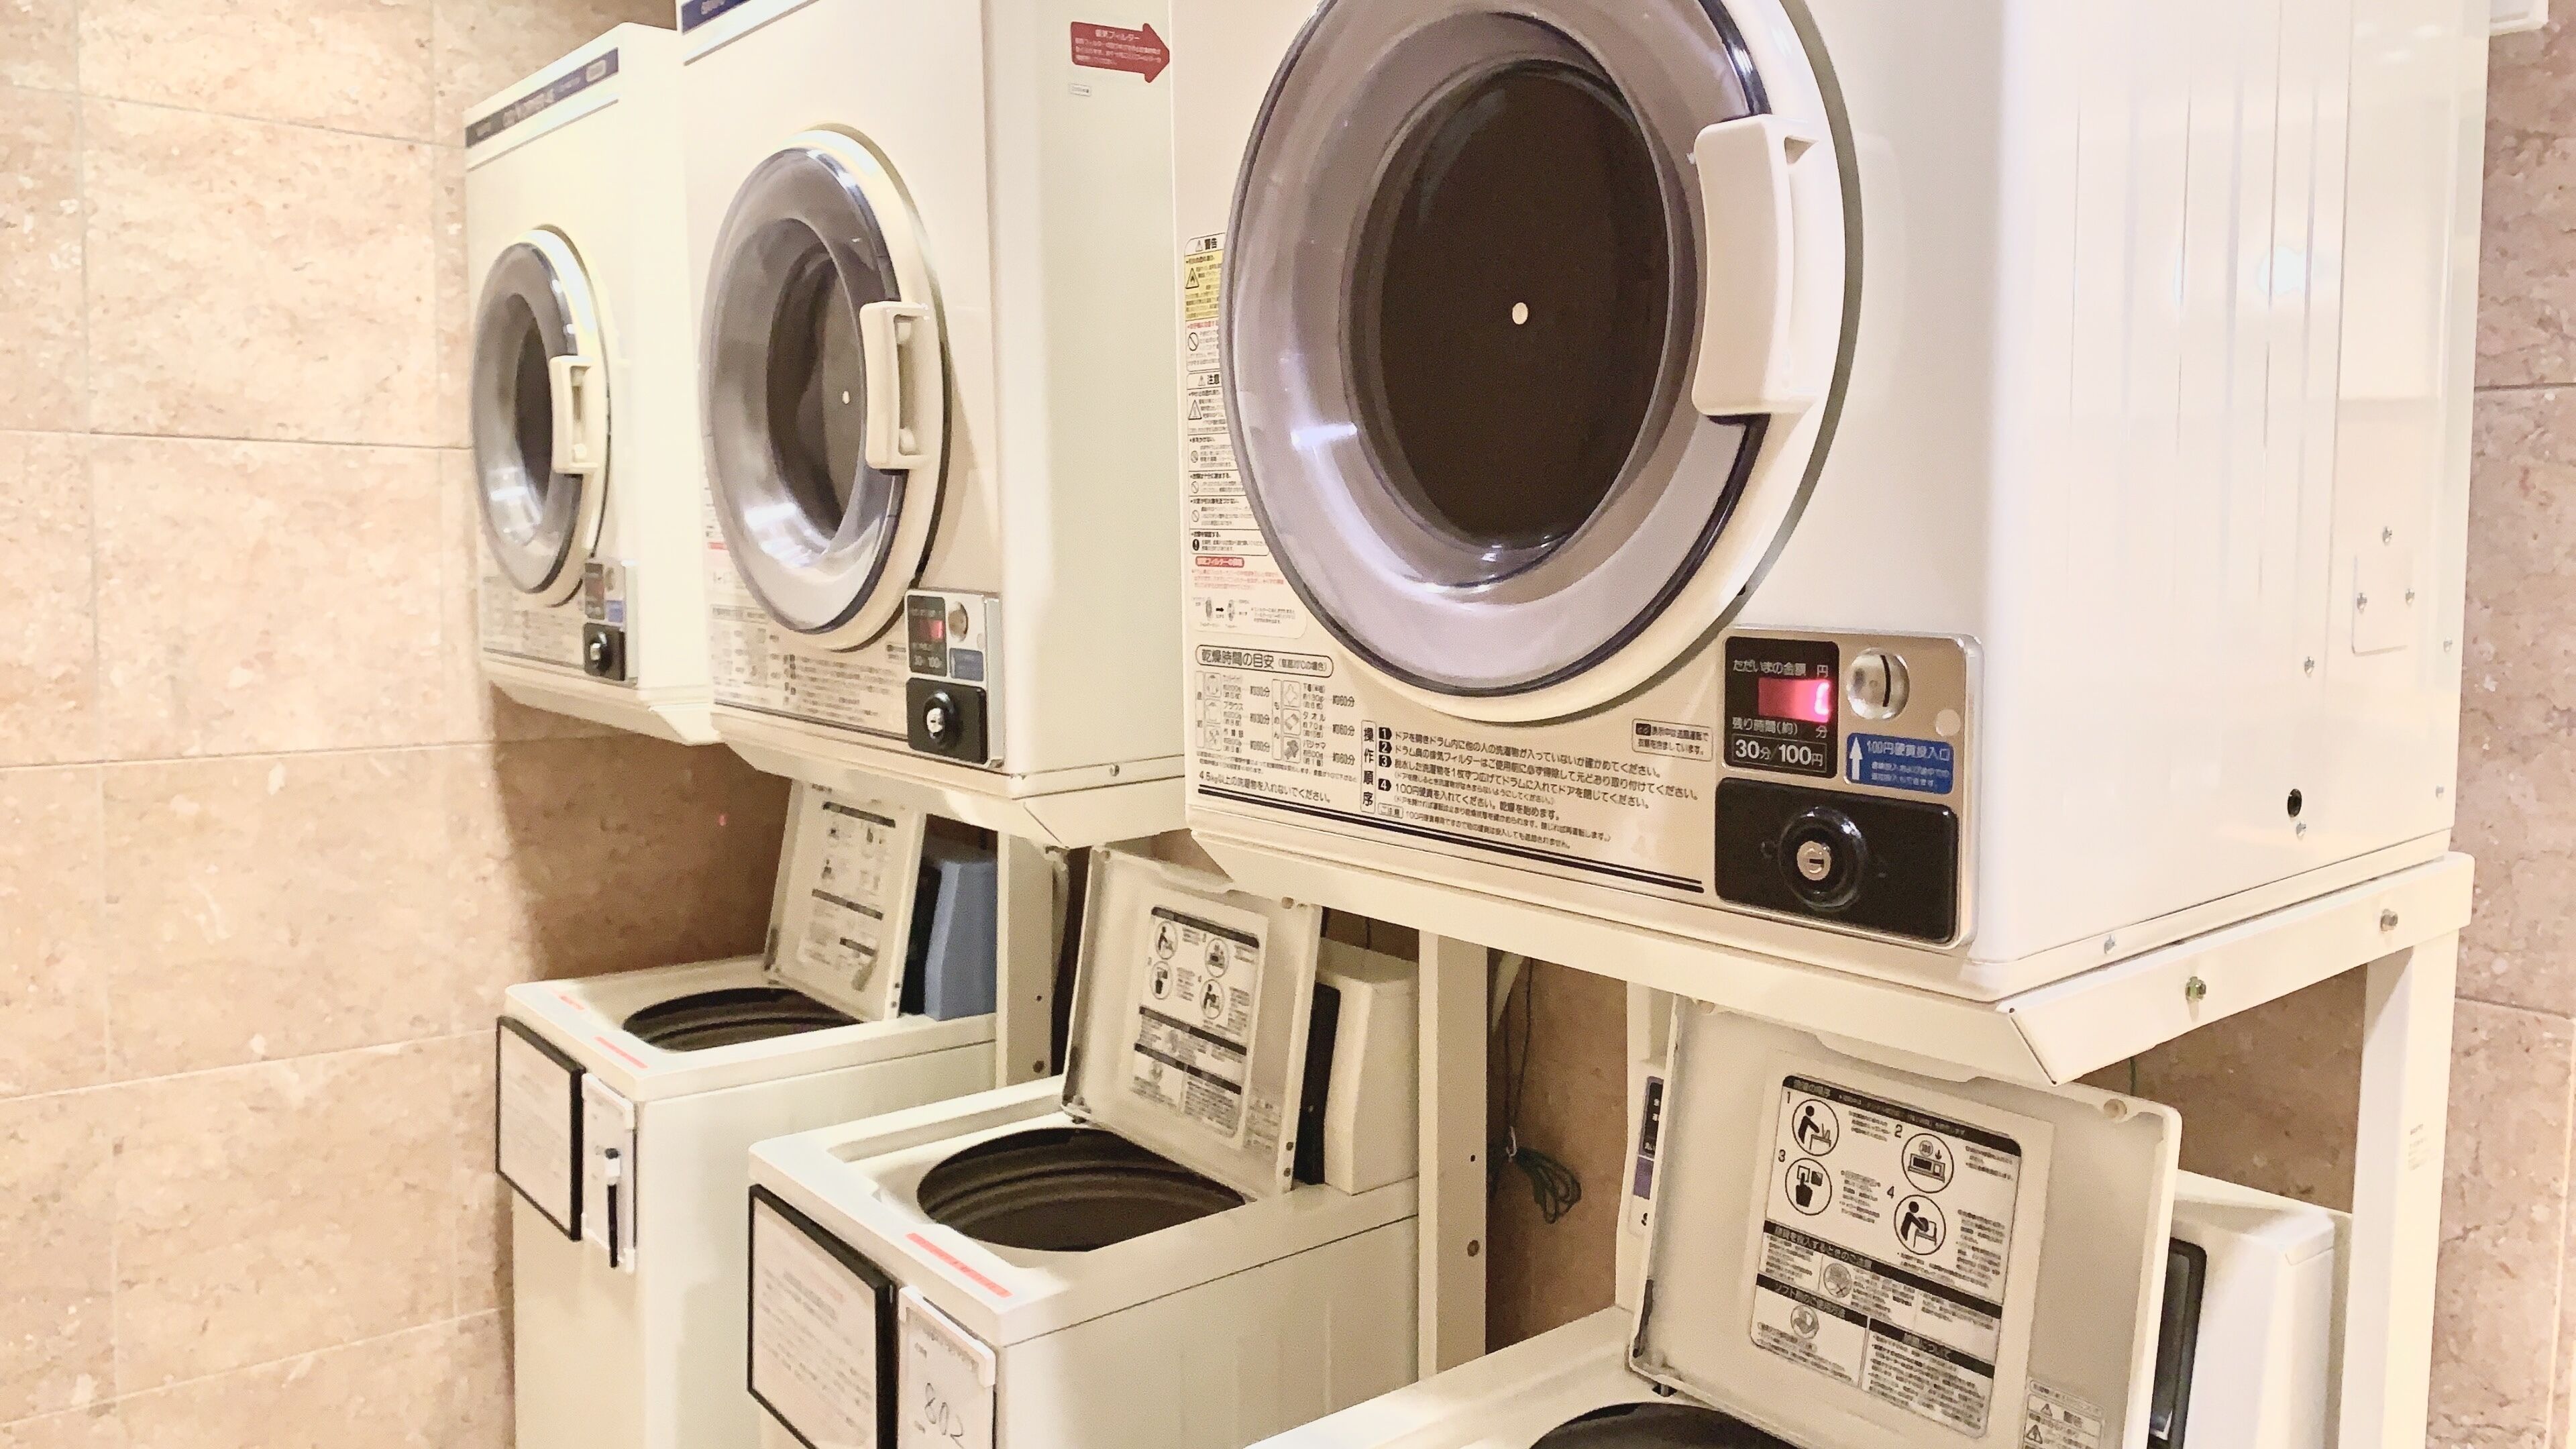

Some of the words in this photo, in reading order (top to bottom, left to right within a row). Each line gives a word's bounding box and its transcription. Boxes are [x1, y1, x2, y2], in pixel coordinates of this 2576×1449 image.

[1201, 649, 1275, 669] 乾燥時間の目安
[1733, 659, 1807, 676] ただいまの金額
[1817, 664, 1829, 678] 円
[1732, 716, 1798, 735] 残り時間(約)
[1815, 725, 1828, 739] 分
[1866, 740, 1950, 761] 100円硬貨投入口
[1363, 727, 1374, 806] 操作順序
[1787, 1091, 1791, 1104] 1
[1894, 1124, 1903, 1138] 2
[1778, 1148, 1786, 1163] 3
[1886, 1185, 1895, 1199] 4
